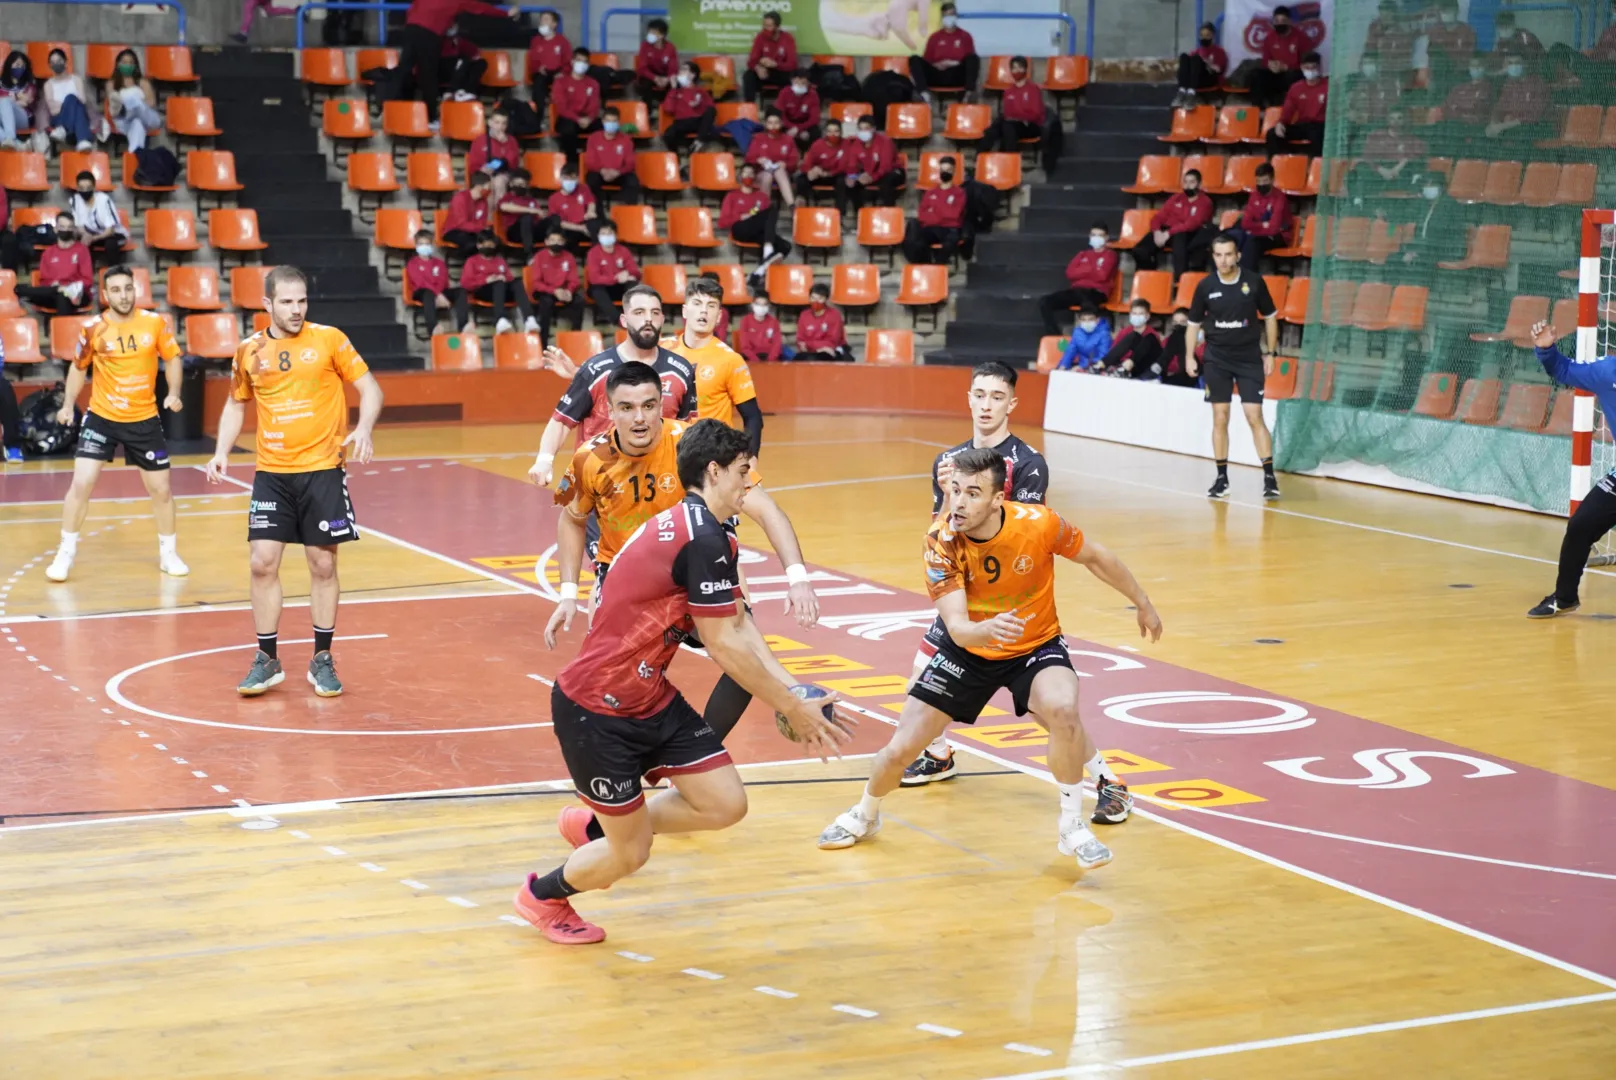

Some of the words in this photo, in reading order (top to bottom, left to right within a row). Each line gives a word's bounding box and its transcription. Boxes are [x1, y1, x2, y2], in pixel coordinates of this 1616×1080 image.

[116, 335, 137, 354] 14
[278, 350, 292, 372] 8
[628, 473, 656, 503] 13
[983, 555, 1001, 584] 9
[941, 659, 966, 676] AMAT
